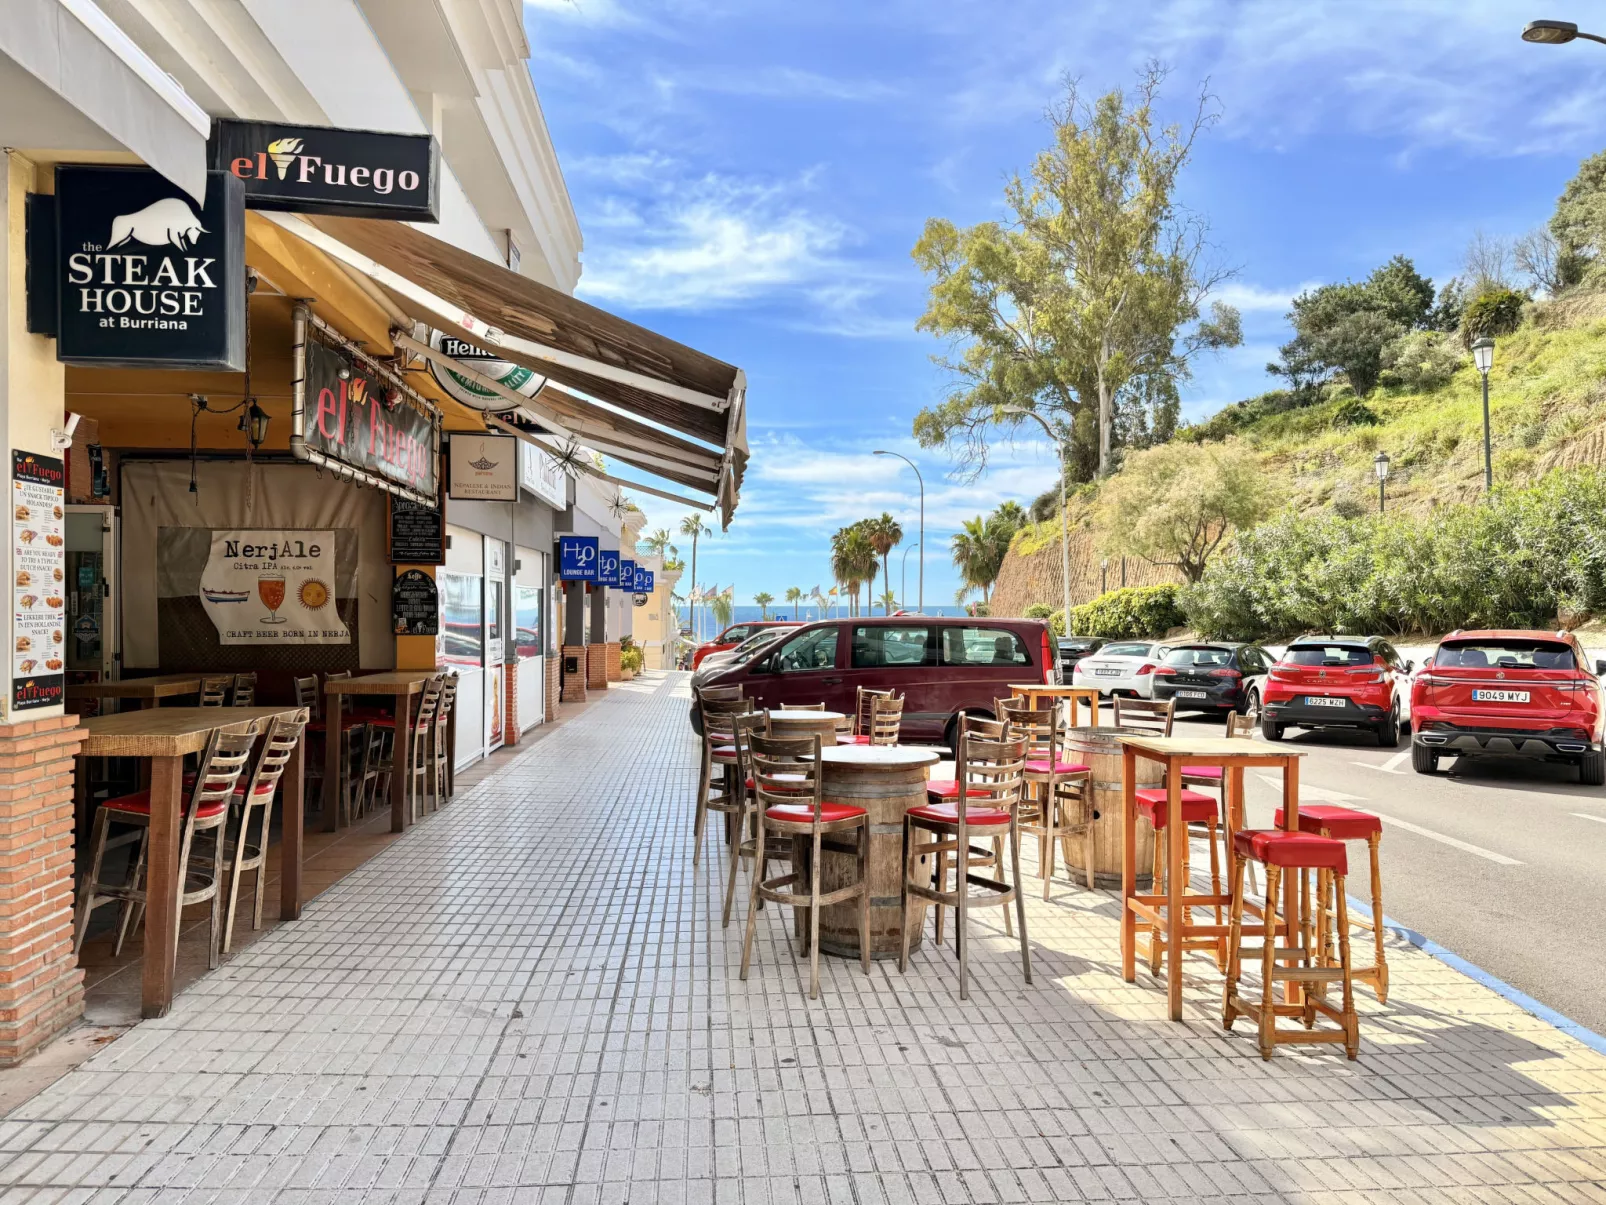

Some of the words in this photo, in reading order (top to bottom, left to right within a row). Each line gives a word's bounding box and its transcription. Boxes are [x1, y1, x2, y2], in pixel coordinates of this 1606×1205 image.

[230, 152, 268, 180] el
[296, 156, 420, 195] Fuego
[82, 241, 102, 252] the
[68, 253, 217, 288] STEAK
[79, 288, 204, 316] HOUSE
[99, 316, 116, 329] at
[120, 316, 188, 331] Burriana
[317, 377, 346, 446] el
[368, 396, 427, 486] Fuego
[16, 462, 26, 473] el
[32, 464, 62, 480] Fuego
[224, 540, 321, 560] NerjAle
[16, 688, 26, 700] el
[33, 685, 61, 698] Fuego
[1479, 691, 1505, 700] 9049
[1507, 693, 1528, 701] MYJ
